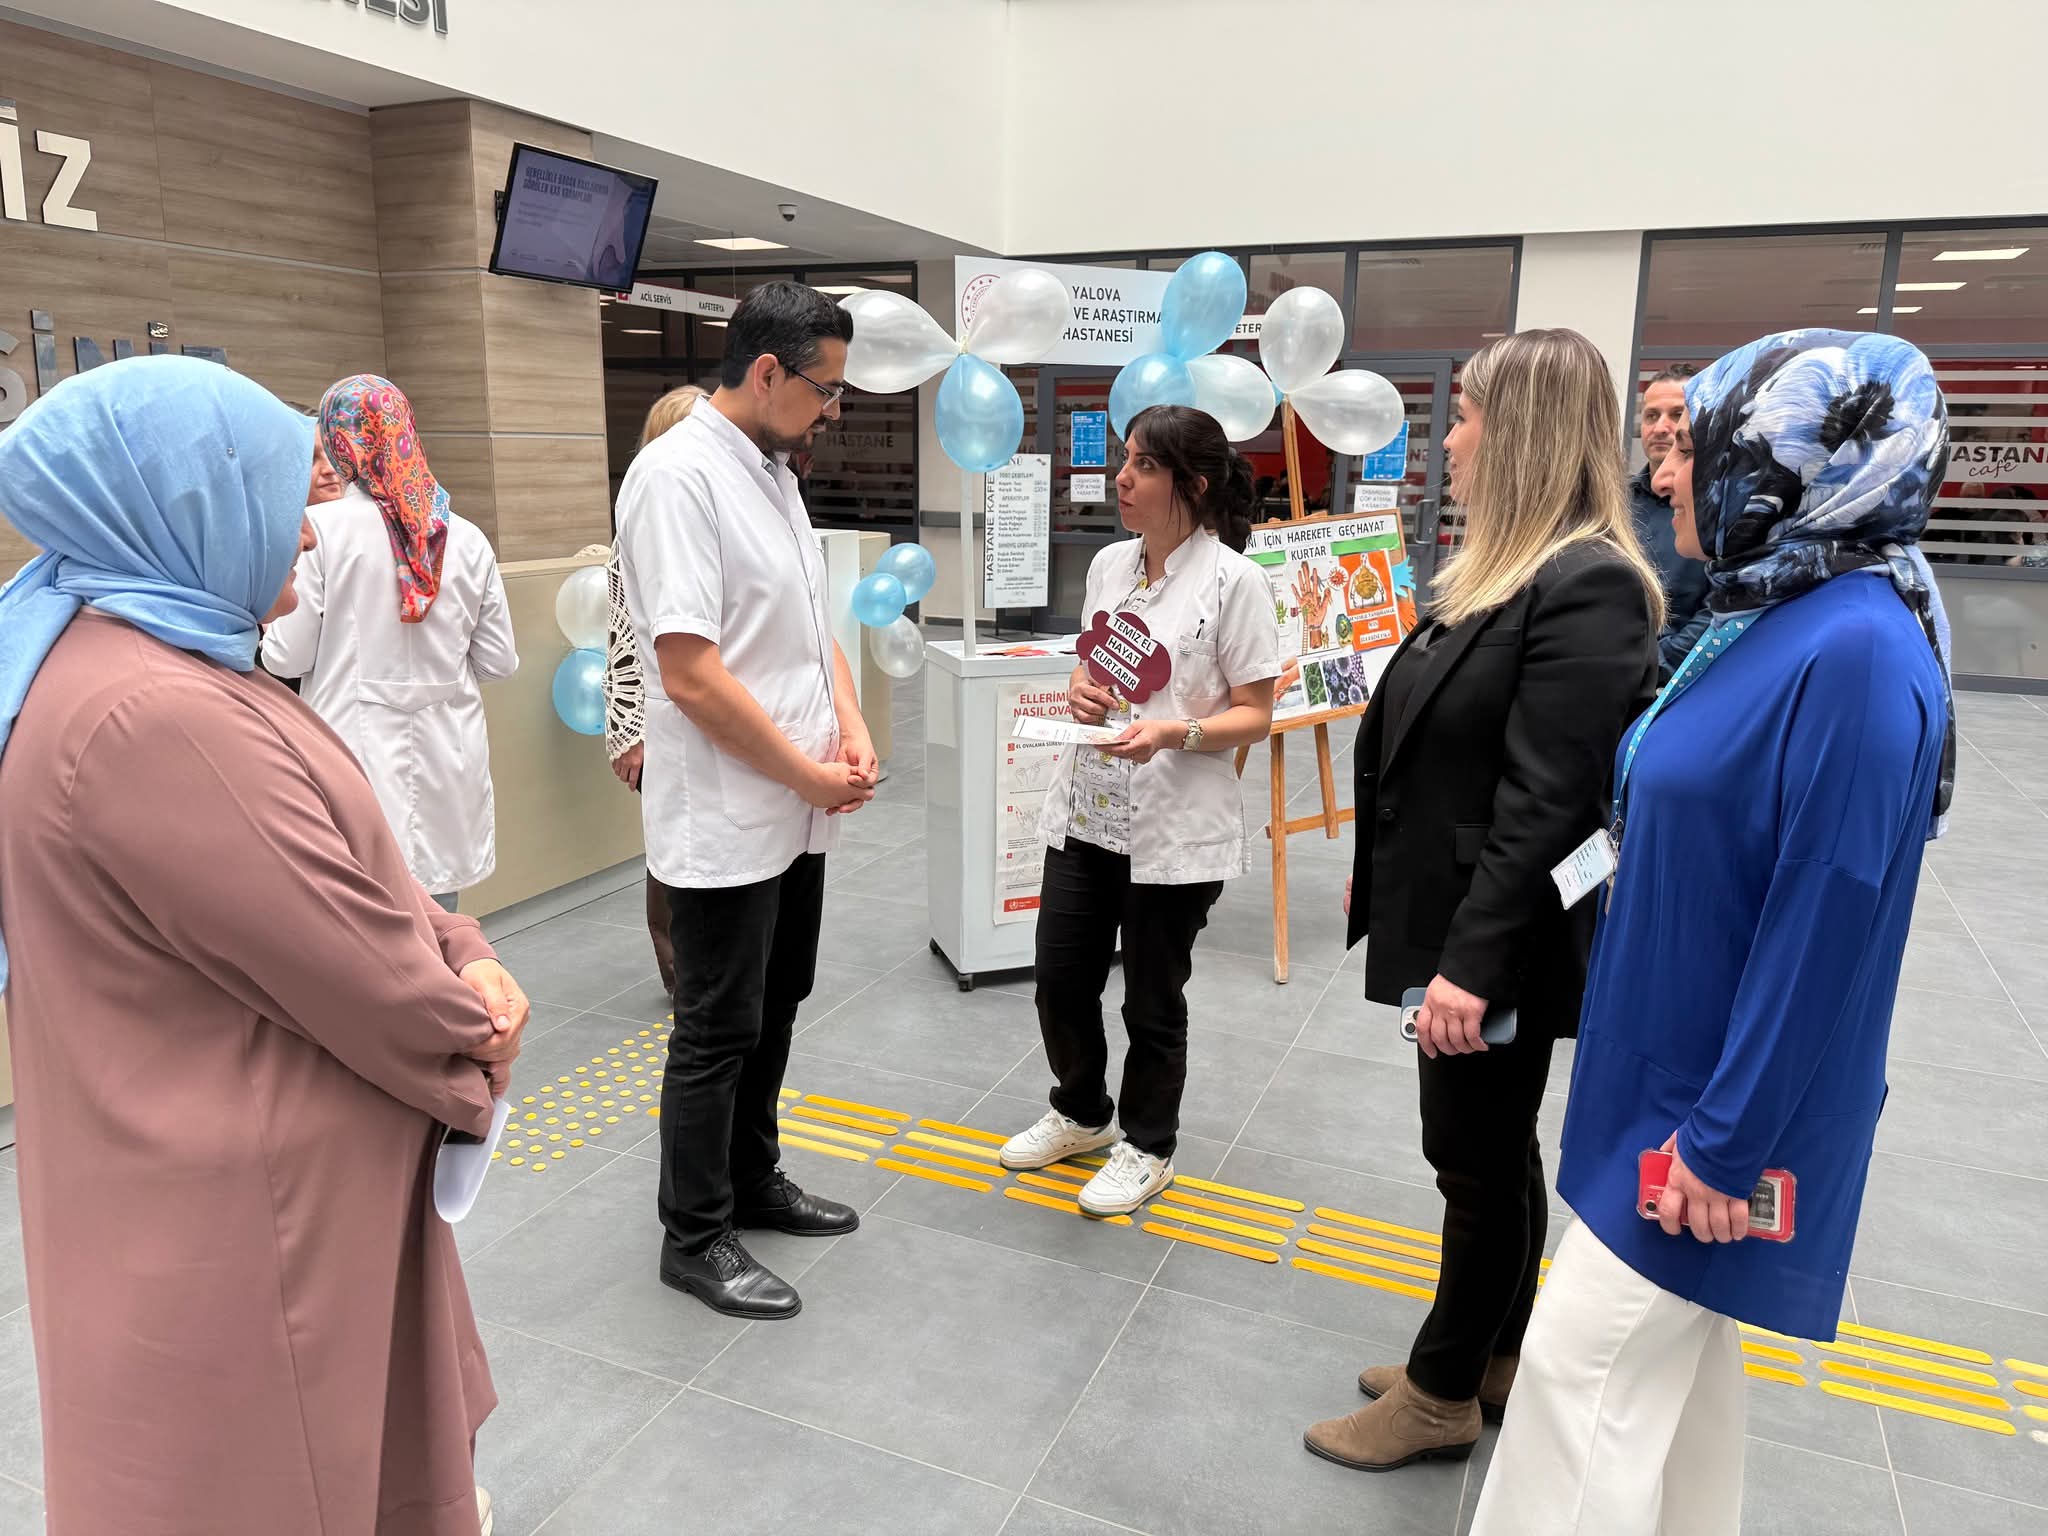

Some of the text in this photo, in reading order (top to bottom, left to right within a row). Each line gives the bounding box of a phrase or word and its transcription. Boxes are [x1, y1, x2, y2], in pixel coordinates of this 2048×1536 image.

[640, 291, 672, 305] ACİL SERVİS
[1072, 286, 1121, 302] YALOVA
[698, 302, 725, 313] KAFETERYA
[1073, 307, 1090, 321] VE
[1063, 327, 1133, 343] HASTANESİ
[986, 473, 995, 582] HASTANE KAFE
[1263, 533, 1283, 549] İÇİN
[1287, 527, 1332, 544] HAREKETE
[1338, 524, 1356, 537] GEÇ
[1356, 520, 1385, 534] HAYAT
[1290, 546, 1327, 561] KURTAR
[1113, 617, 1152, 652] TEMİZ EL
[1108, 637, 1140, 665] HAYAT
[1093, 648, 1137, 691] KURTARIR
[1013, 707, 1046, 718] NASIL
